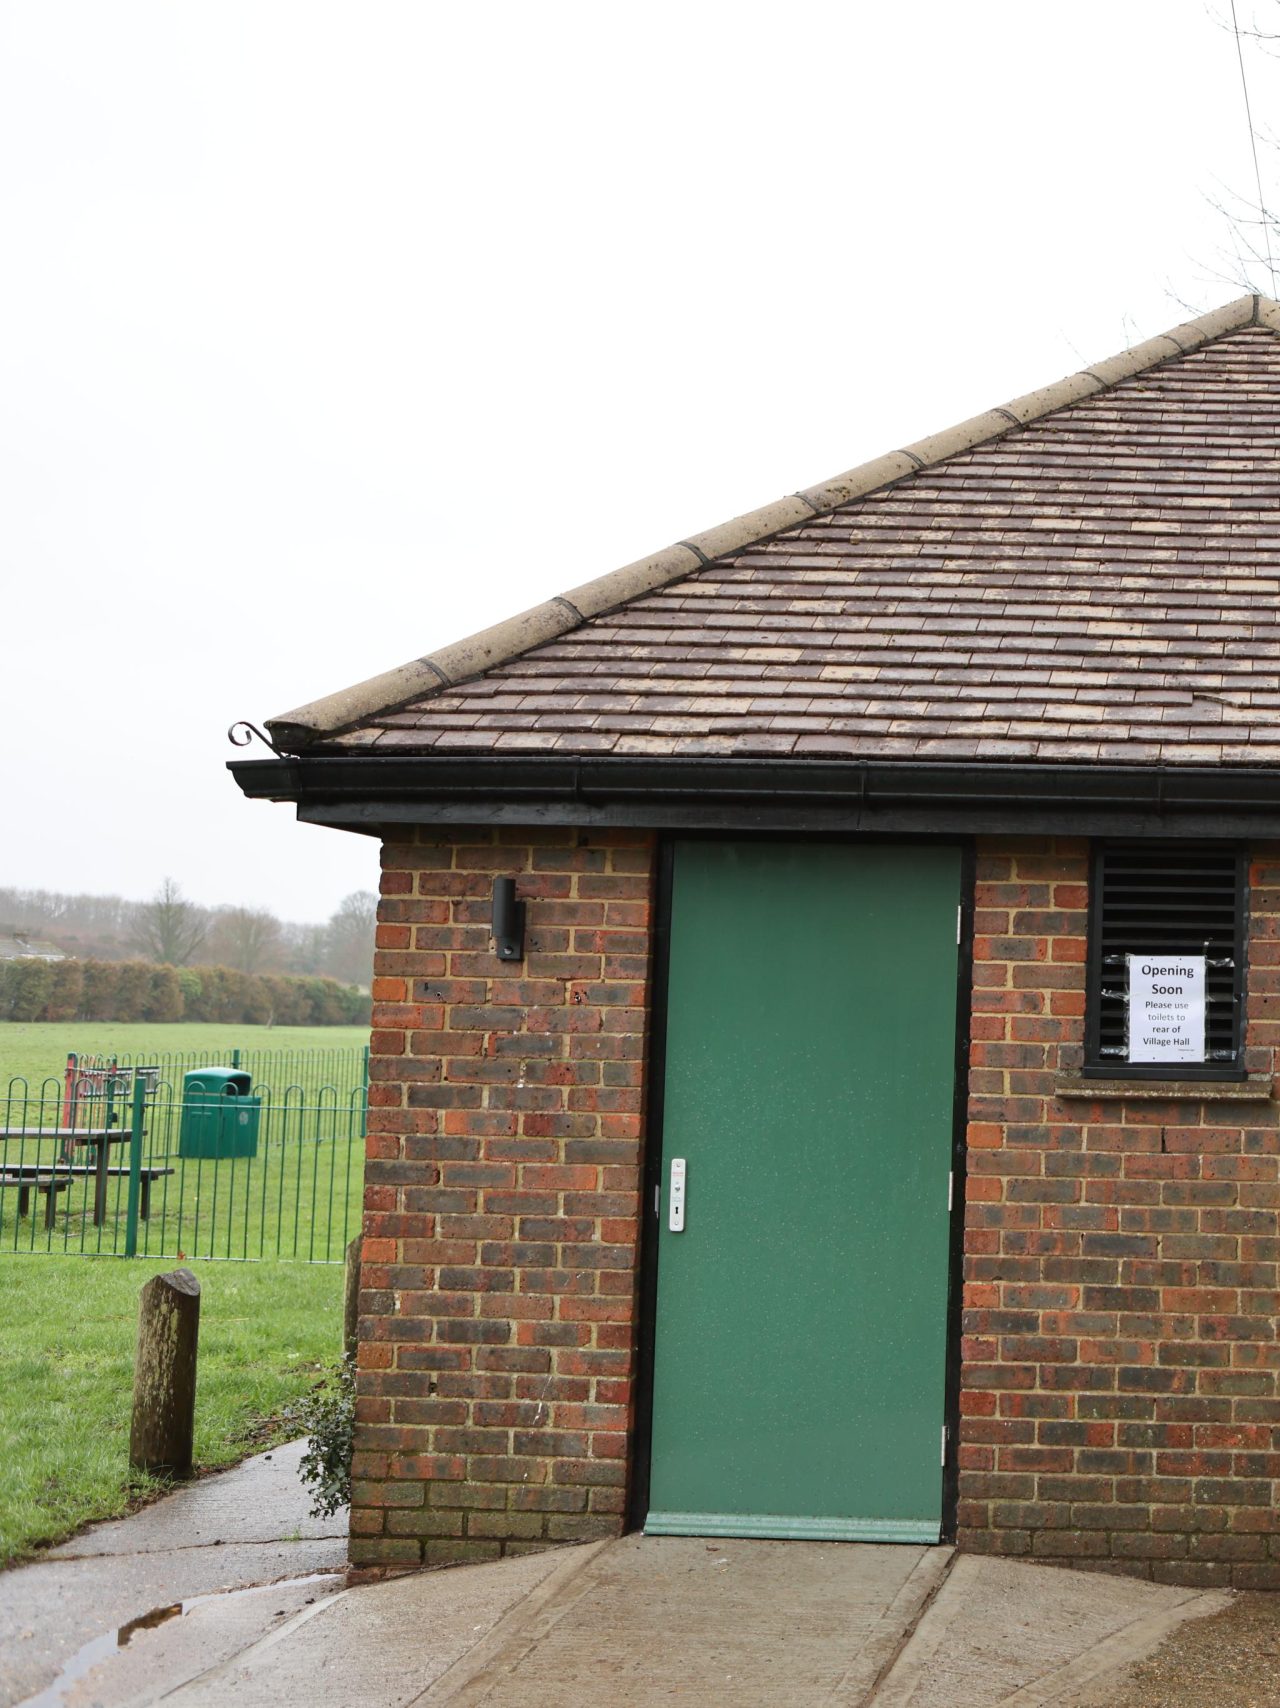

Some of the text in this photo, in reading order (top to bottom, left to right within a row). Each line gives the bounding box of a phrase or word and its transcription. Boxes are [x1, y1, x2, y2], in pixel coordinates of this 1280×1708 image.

[1141, 965, 1194, 978] Opening
[1151, 984, 1183, 995] Soon
[1145, 1001, 1172, 1009] Please
[1148, 1013, 1174, 1021] toilets
[1171, 1025, 1181, 1033] of
[1143, 1038, 1171, 1046] Village
